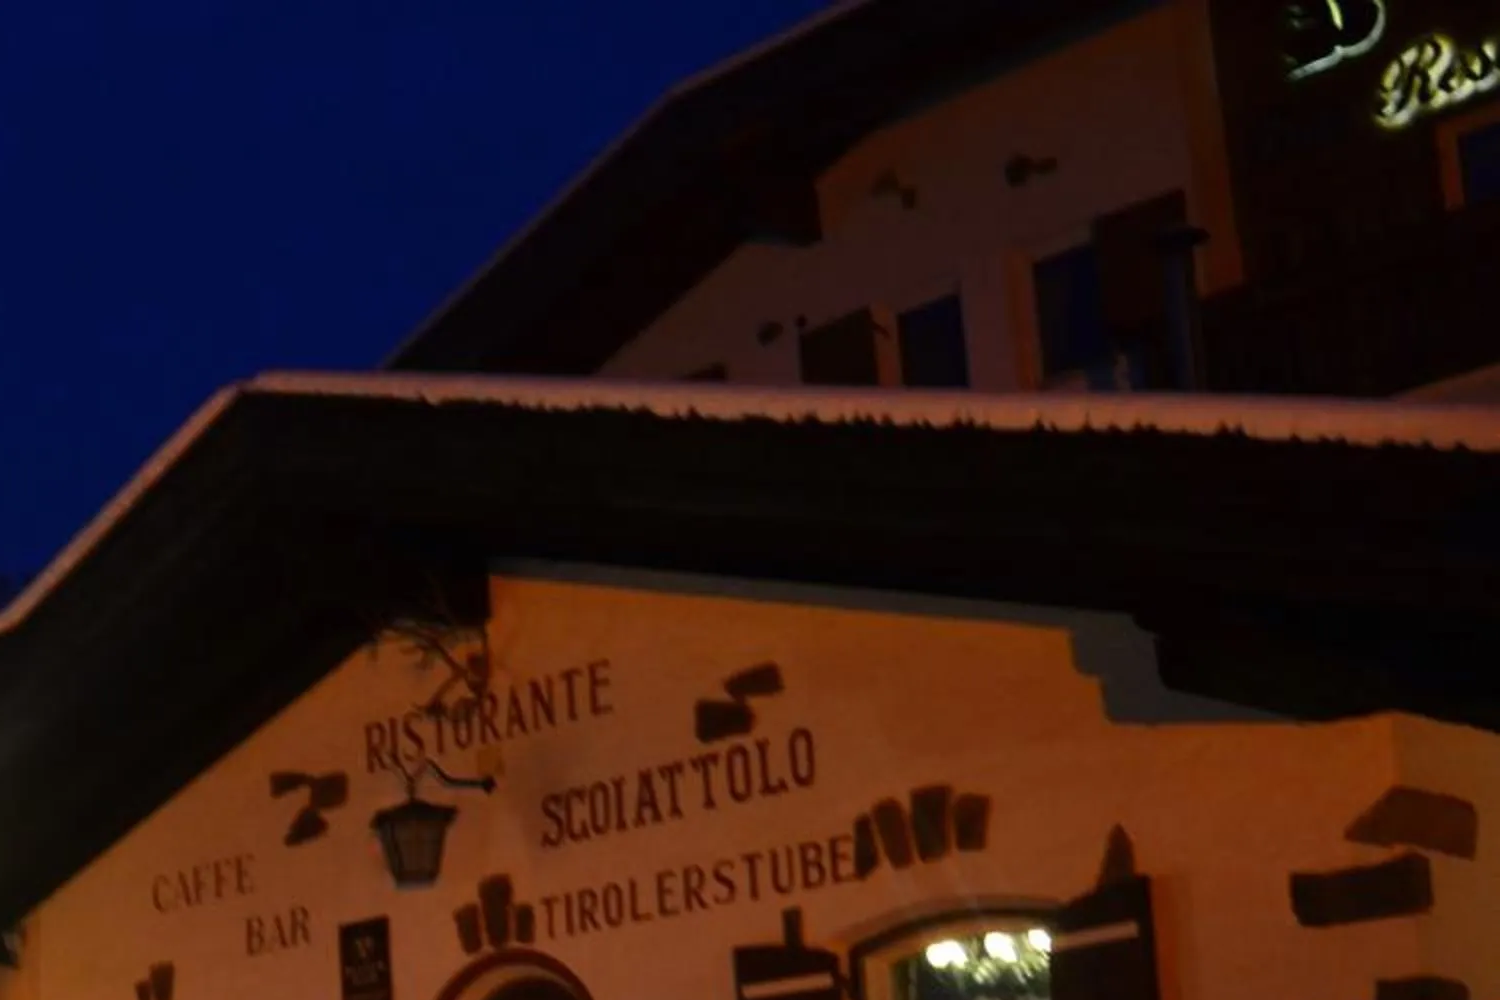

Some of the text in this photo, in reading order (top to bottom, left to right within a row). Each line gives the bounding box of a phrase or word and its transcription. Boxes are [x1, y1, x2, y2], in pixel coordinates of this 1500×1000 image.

[364, 659, 612, 774] RISTORANTE
[541, 727, 815, 848] SCOIATTOLO
[245, 905, 311, 956] BAR
[540, 835, 856, 938] TIROLERSTUBE
